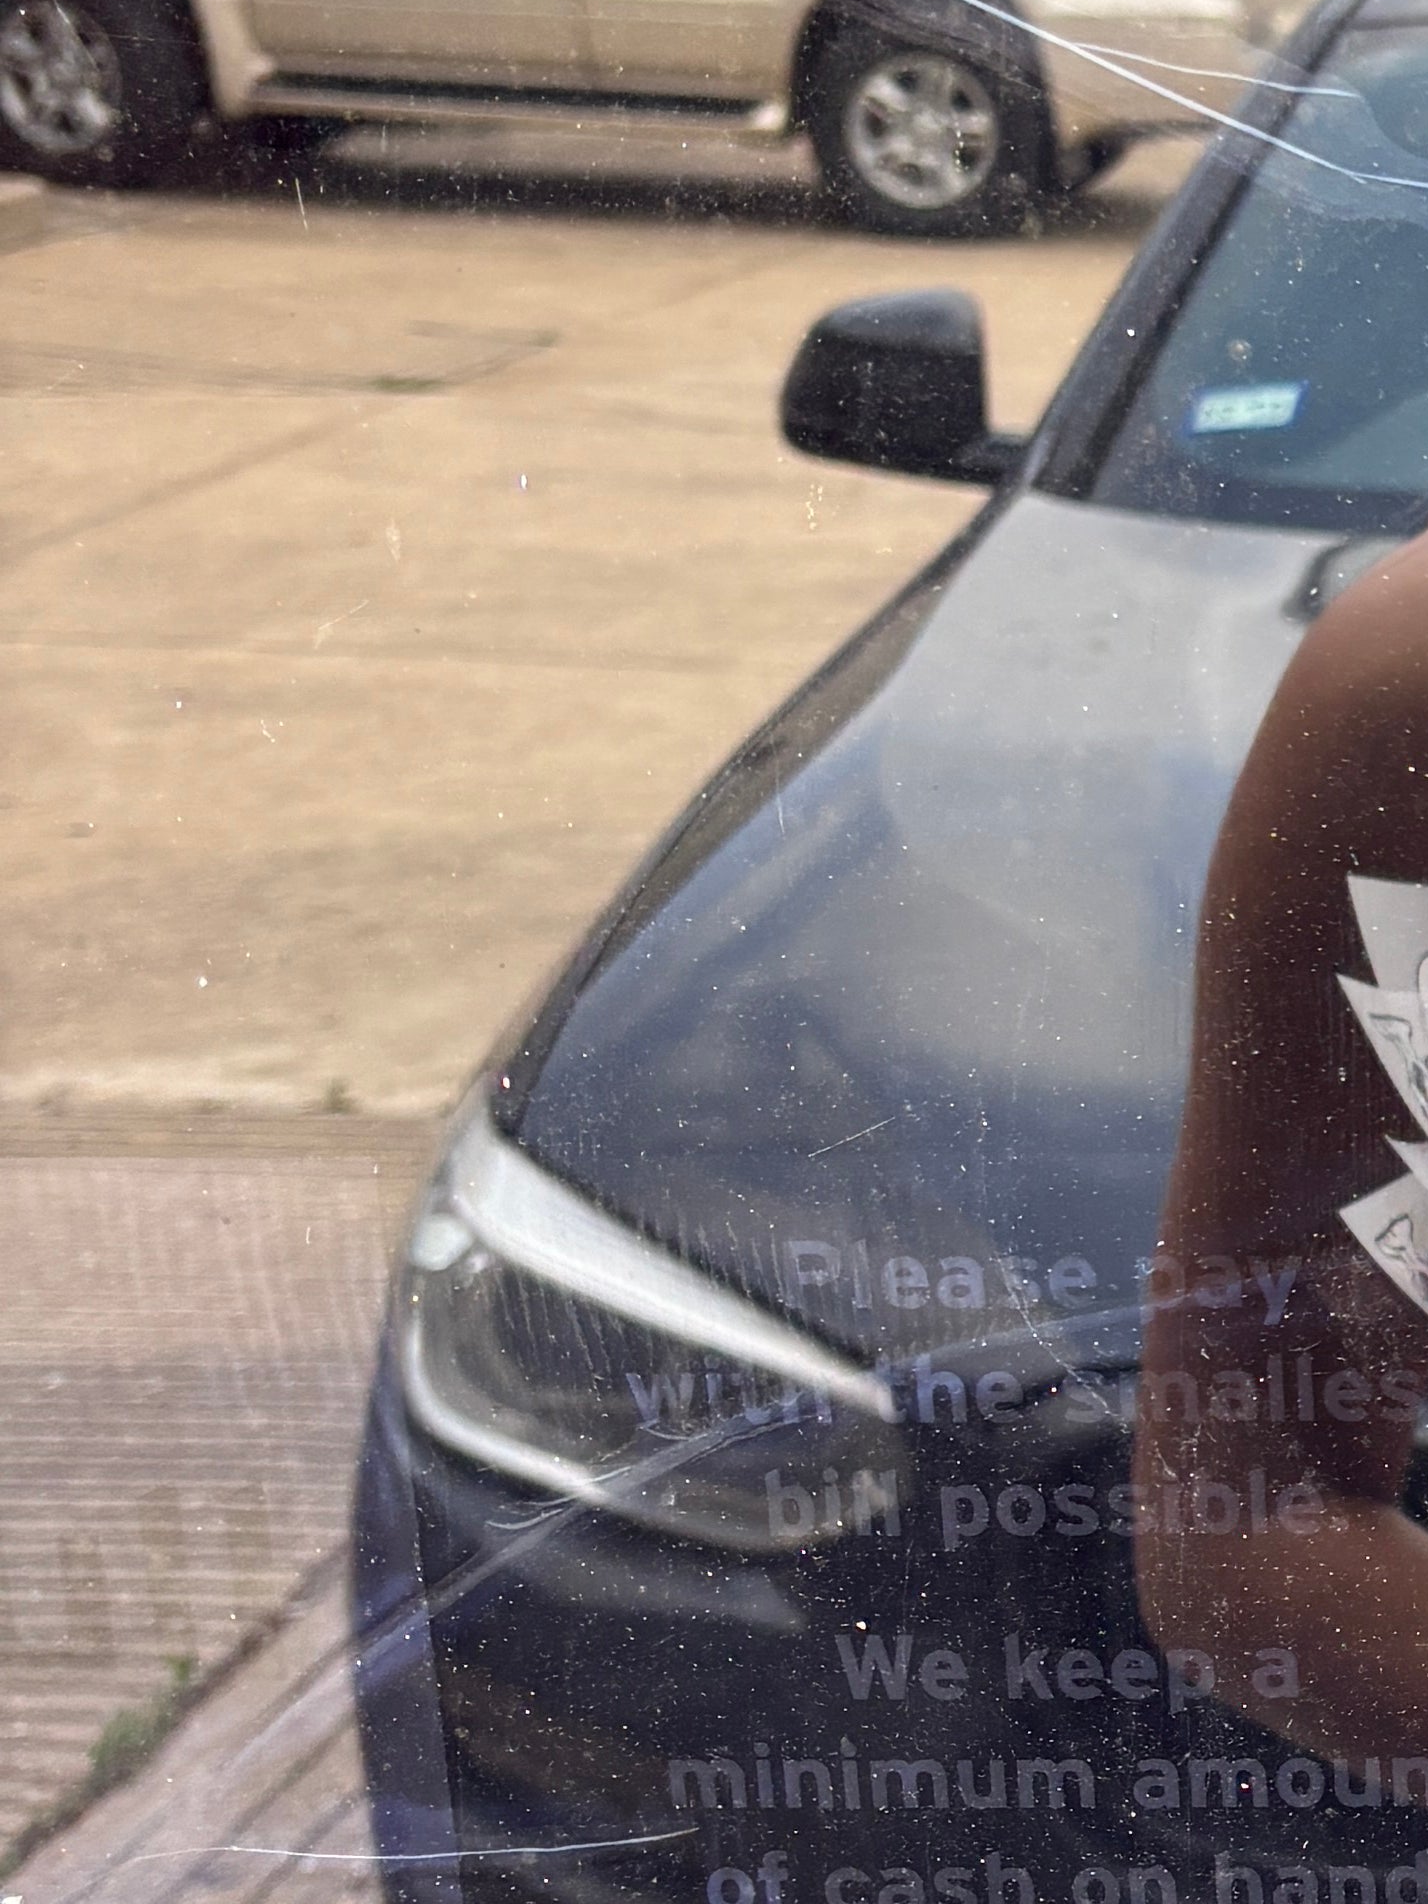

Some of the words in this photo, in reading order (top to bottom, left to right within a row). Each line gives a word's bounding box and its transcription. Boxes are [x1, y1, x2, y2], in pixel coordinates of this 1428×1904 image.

[787, 1238, 1098, 1310] Please
[1134, 1252, 1302, 1330] pay
[765, 1467, 901, 1538] bill
[940, 1466, 1350, 1552] possible.
[836, 1633, 968, 1700] We
[1005, 1629, 1217, 1714] keep
[1252, 1646, 1302, 1698] a
[666, 1737, 1097, 1809] minimum
